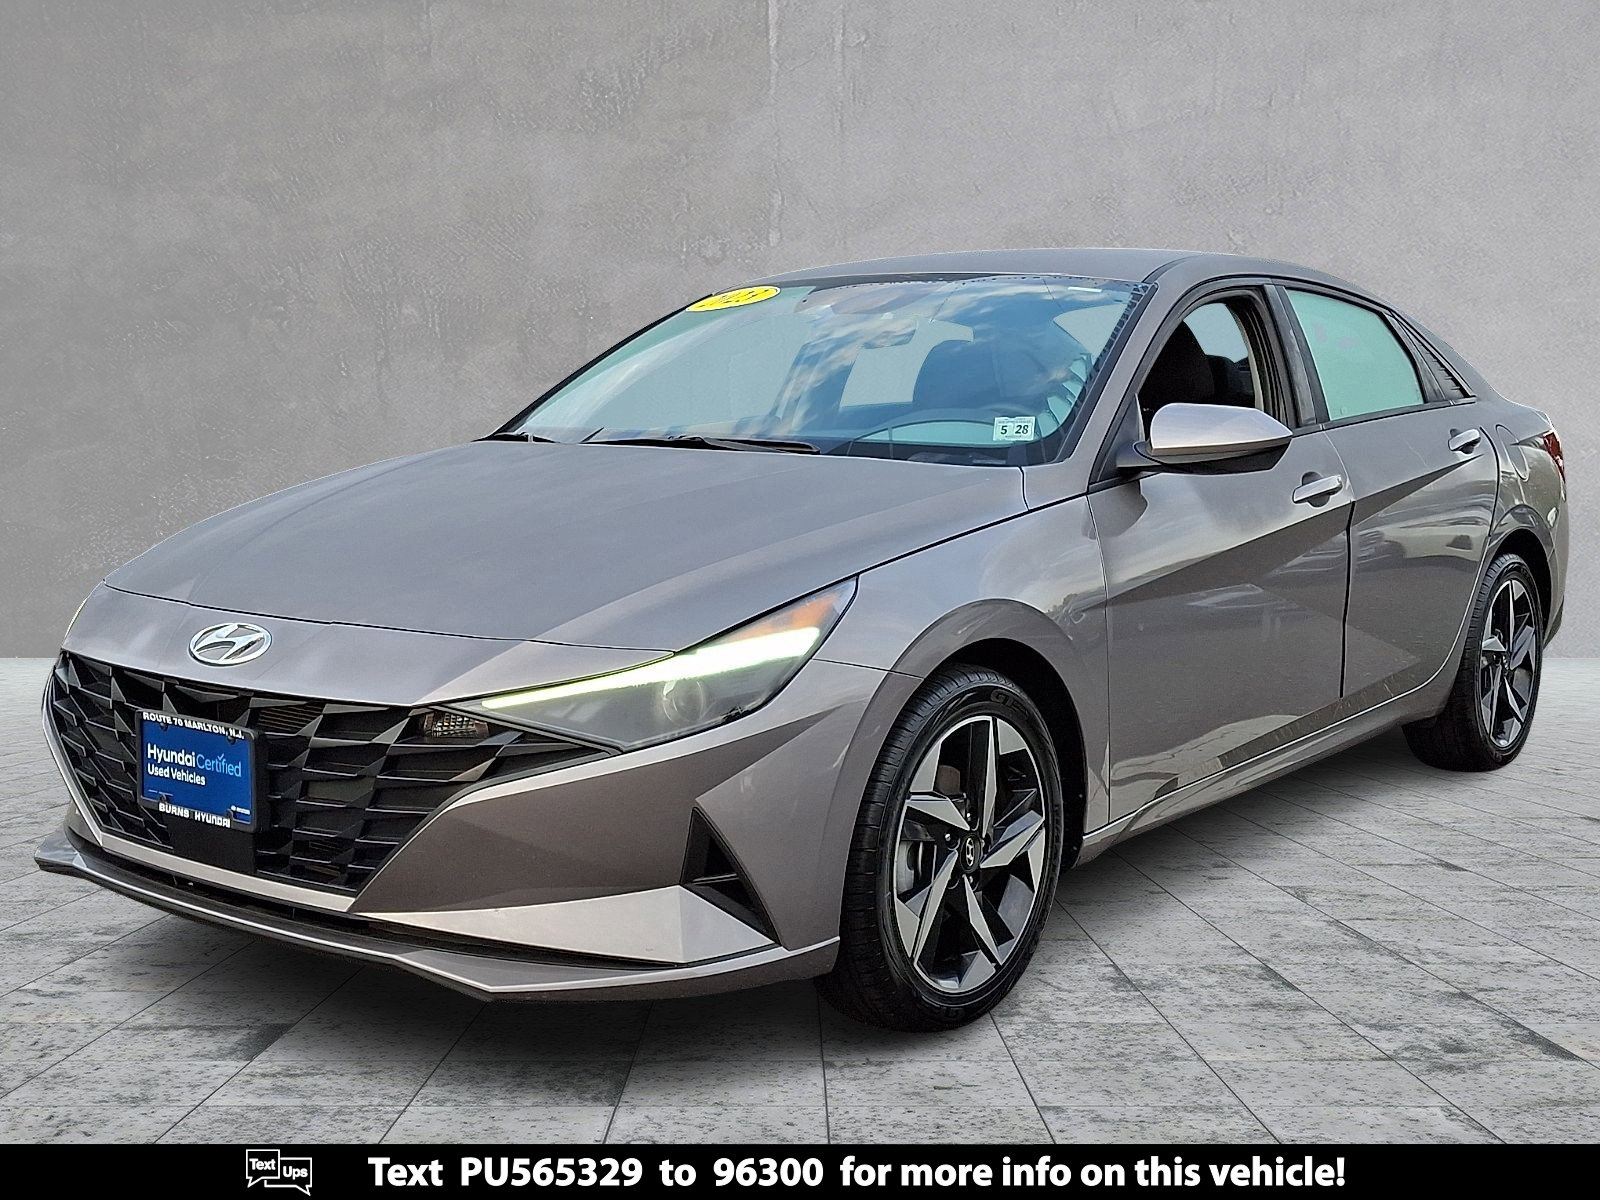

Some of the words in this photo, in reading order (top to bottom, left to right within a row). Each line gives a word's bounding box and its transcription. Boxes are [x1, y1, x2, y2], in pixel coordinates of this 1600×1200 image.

[1000, 425, 1008, 434] 5
[1015, 425, 1029, 434] 28
[143, 711, 172, 725] ROUTE
[147, 743, 196, 767] Hyundai
[147, 763, 170, 778] Used
[171, 769, 206, 786] Vehicles
[159, 802, 190, 818] BURNS
